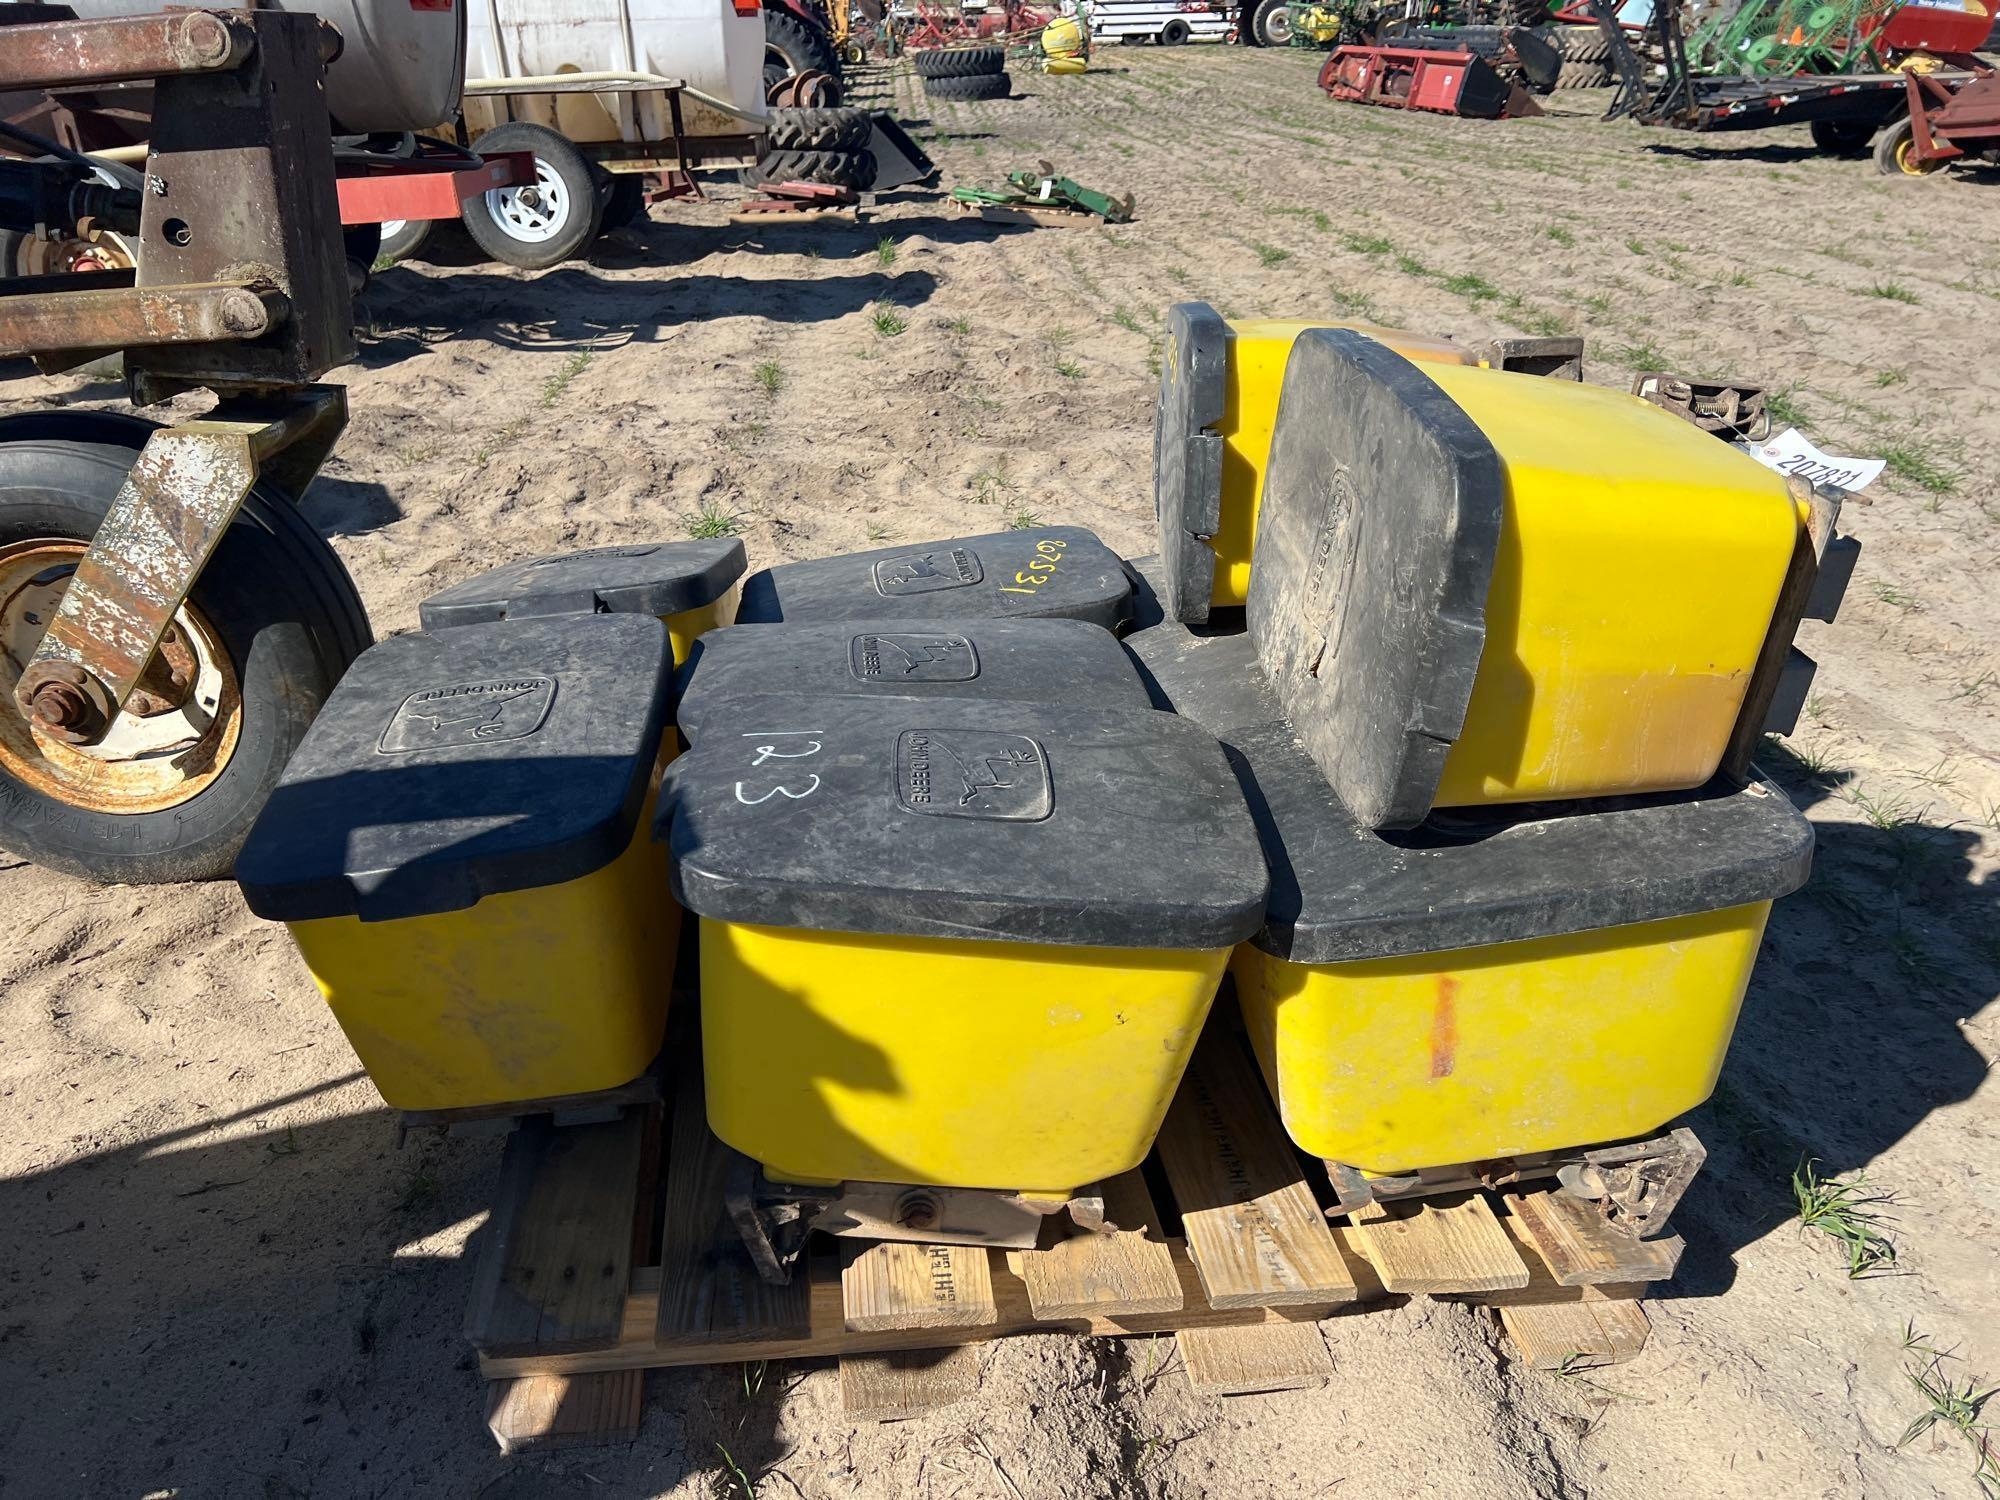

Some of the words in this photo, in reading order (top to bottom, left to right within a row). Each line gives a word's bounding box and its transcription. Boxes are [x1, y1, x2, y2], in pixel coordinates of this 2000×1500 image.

[1777, 454, 1862, 487] 207831
[416, 686, 483, 701] DEERE
[488, 681, 546, 693] JOHN
[907, 732, 929, 760] JOHN
[735, 730, 824, 805] 123
[910, 761, 931, 803] DEERE
